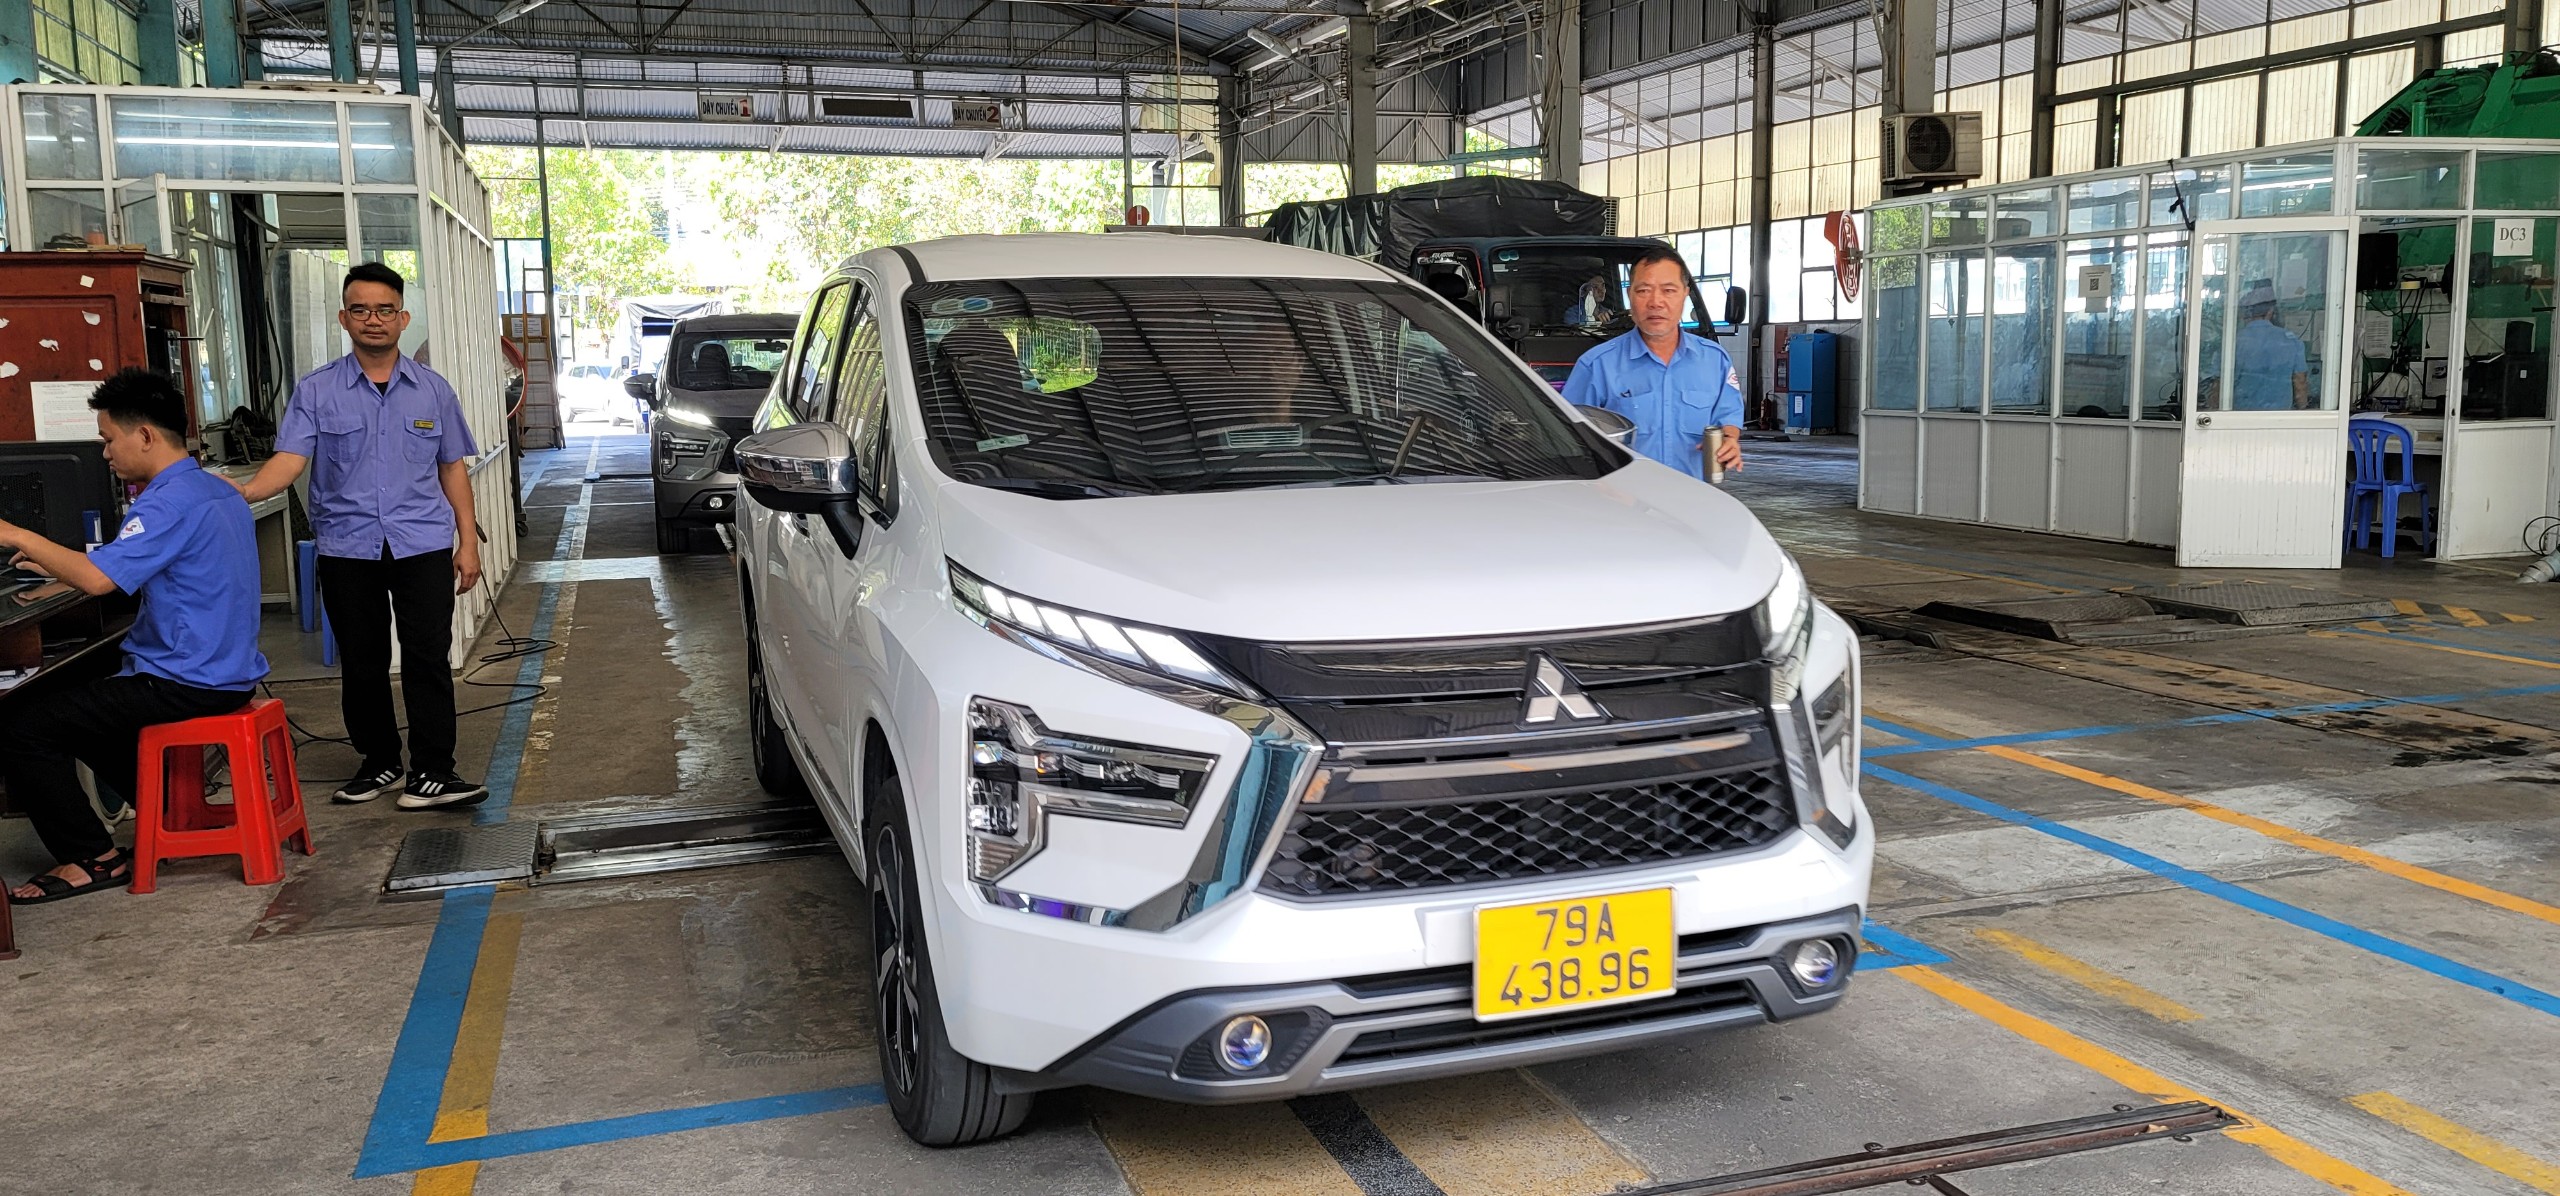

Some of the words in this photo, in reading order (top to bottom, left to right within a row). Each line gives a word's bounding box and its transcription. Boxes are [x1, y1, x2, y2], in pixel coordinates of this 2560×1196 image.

[739, 98, 751, 117] 1
[986, 105, 999, 123] 2
[2499, 227, 2526, 241] DC3
[1535, 902, 1615, 951] 79A
[1500, 949, 1649, 1006] 438.96
